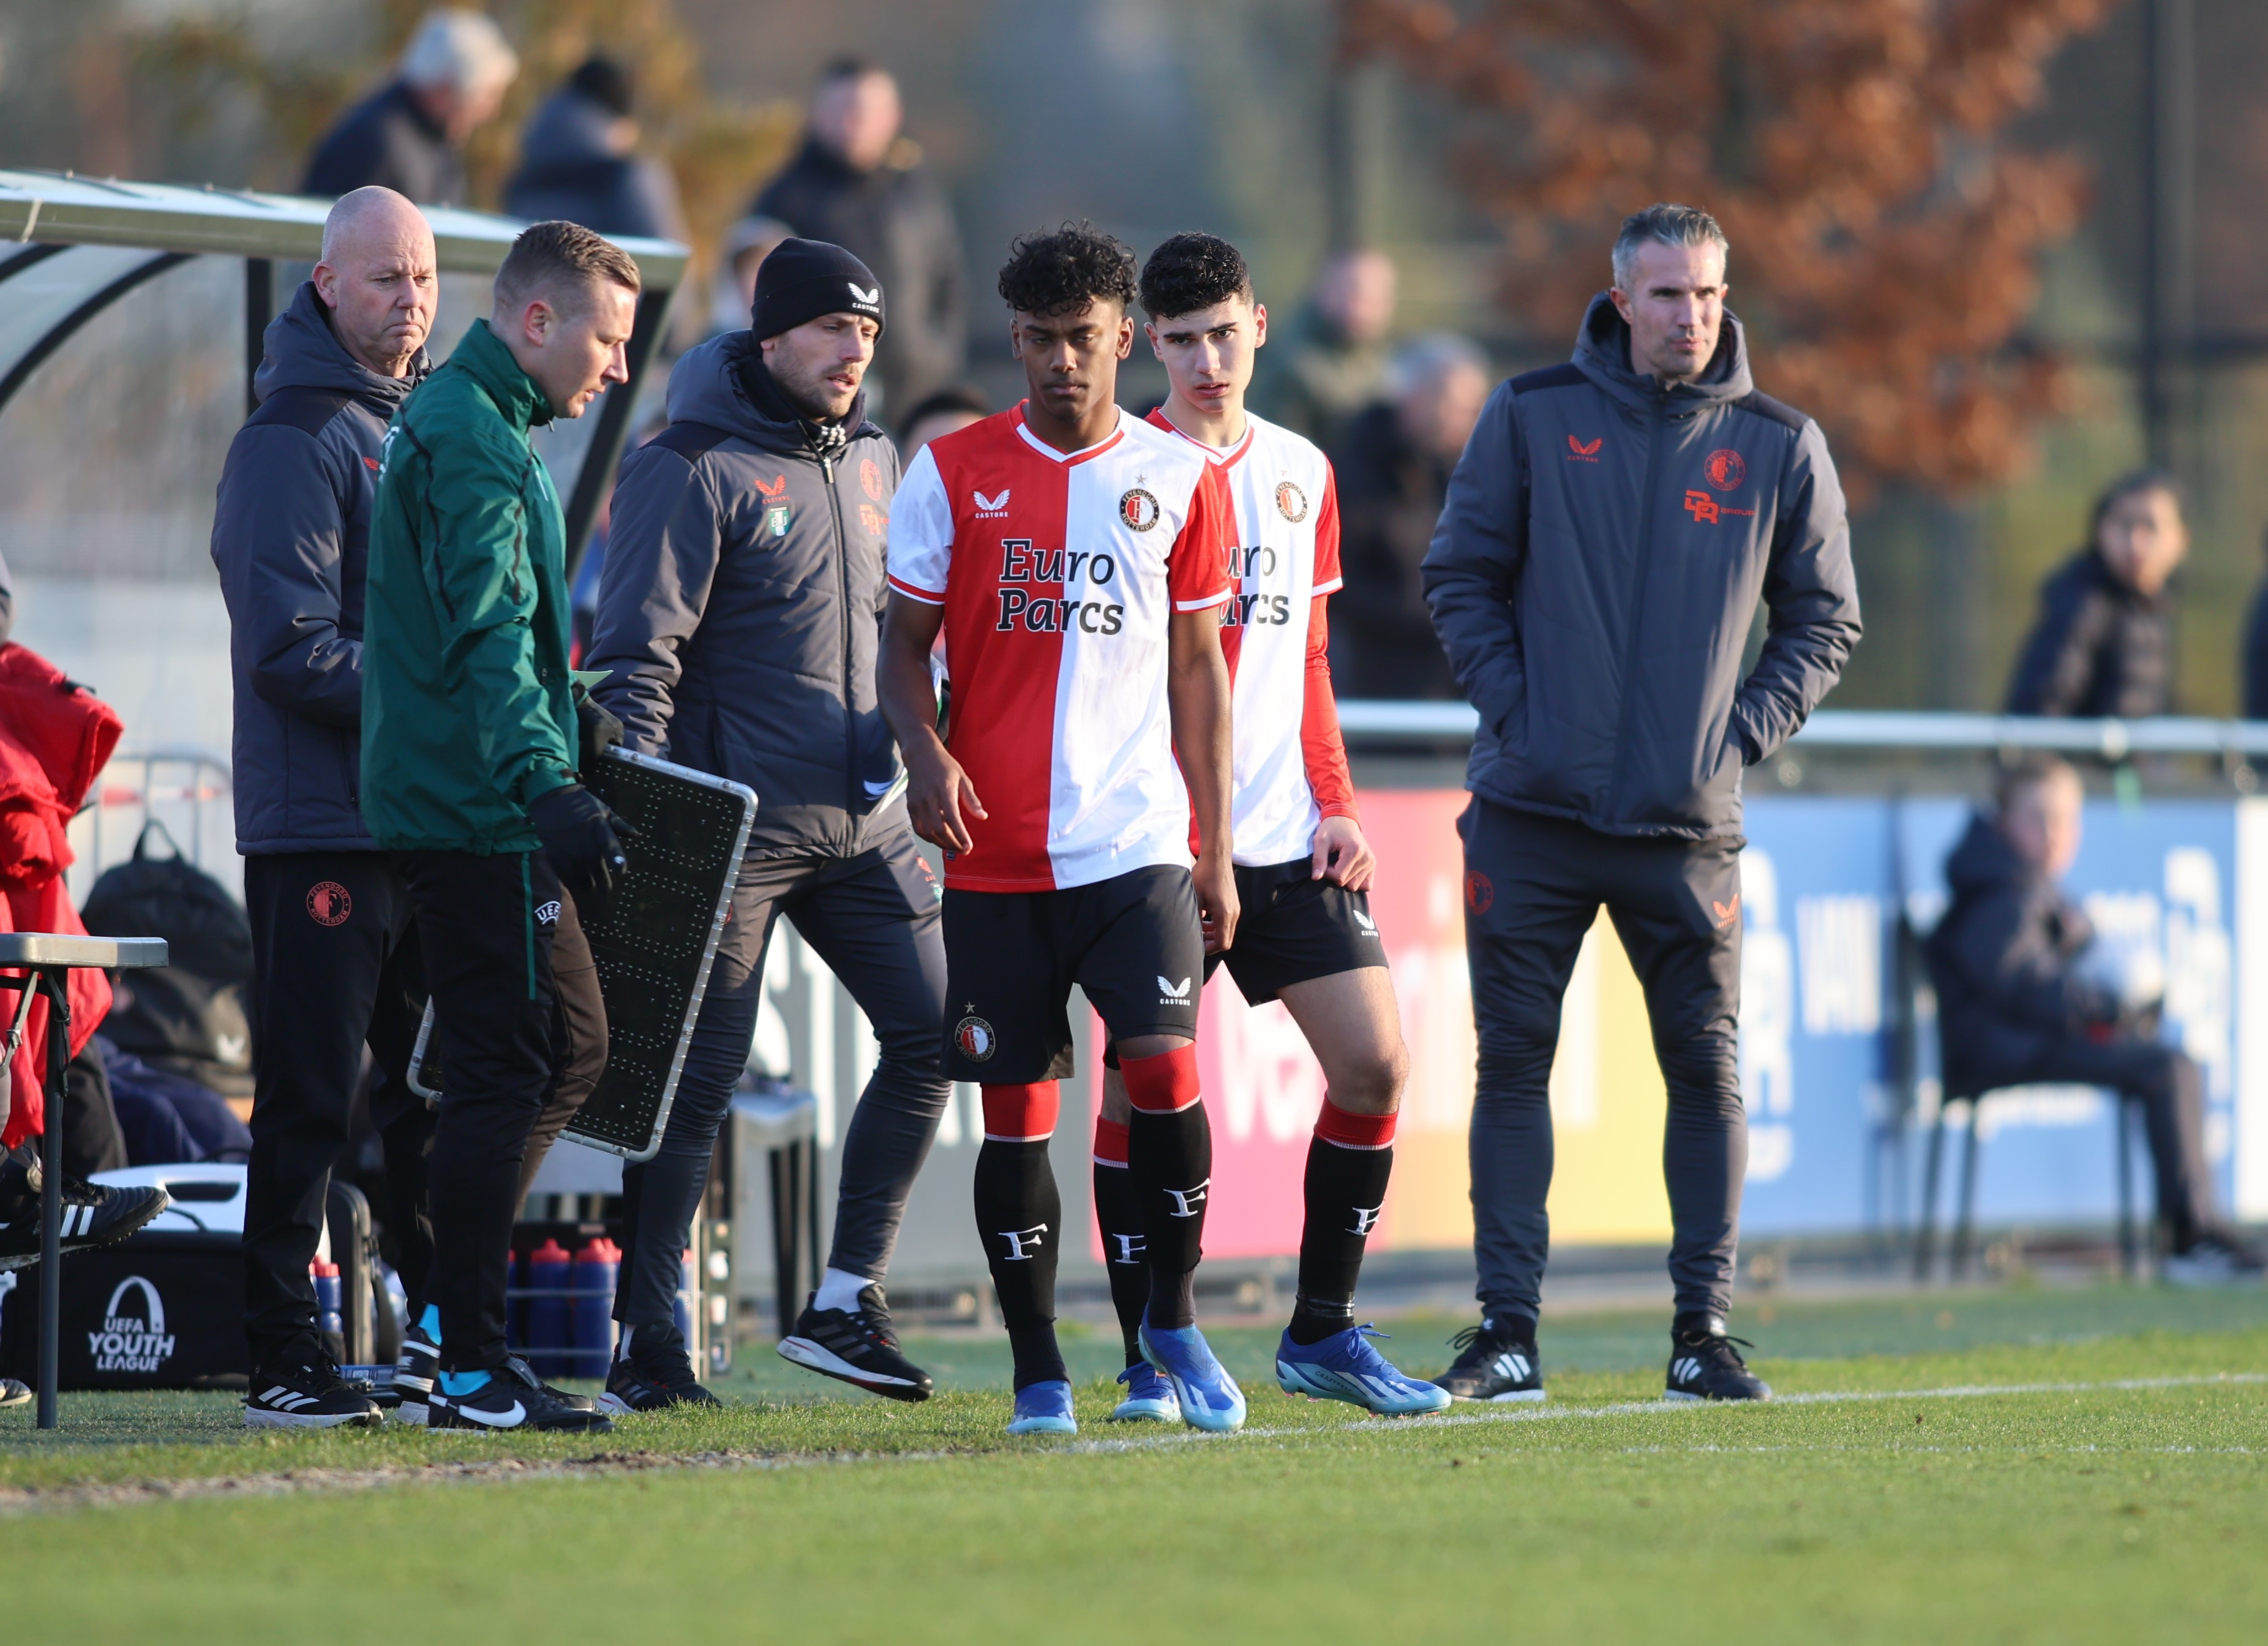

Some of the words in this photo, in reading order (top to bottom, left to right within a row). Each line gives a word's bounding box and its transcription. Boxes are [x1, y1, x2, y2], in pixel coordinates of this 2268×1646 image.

[1122, 490, 1158, 507] FEYENOORD
[1121, 513, 1157, 531] ROTTERDAM
[999, 538, 1114, 585] Euro
[1228, 546, 1276, 577] uro
[996, 588, 1124, 636] Parcs
[1218, 593, 1290, 627] arcs
[310, 883, 347, 898] FEYENOORD
[310, 908, 348, 924] ROTTERDAM
[957, 1019, 991, 1035] FEYENOORD
[1163, 1178, 1211, 1217] F
[1345, 1200, 1384, 1236] F
[998, 1223, 1048, 1260] F
[1113, 1233, 1147, 1263] F
[104, 1318, 145, 1333] UEFA
[88, 1331, 176, 1357] YOUTH
[97, 1354, 160, 1372] LEAGUE
